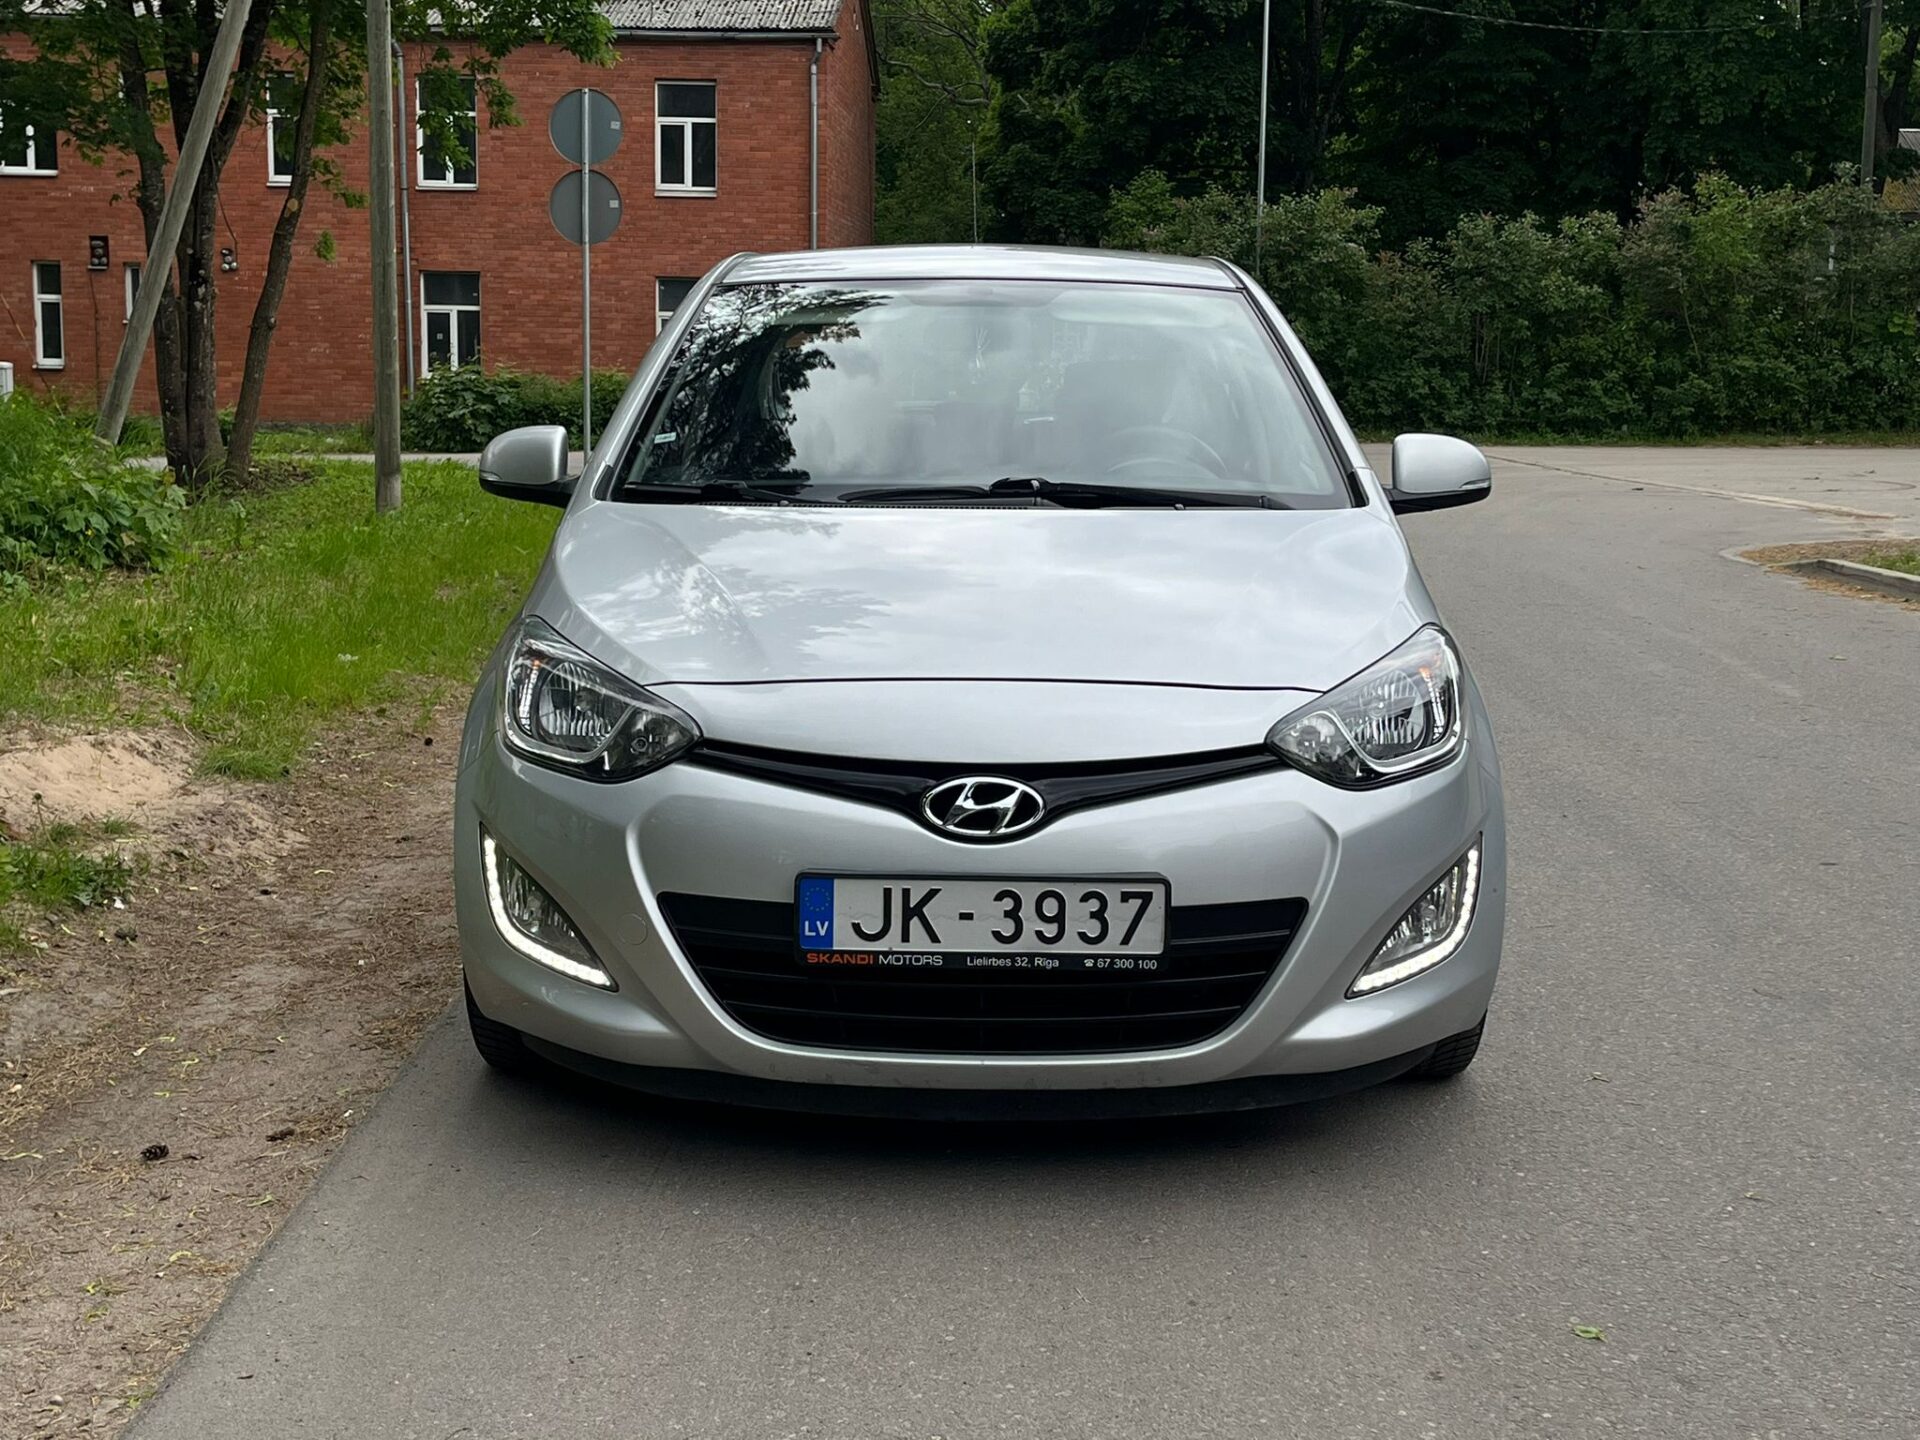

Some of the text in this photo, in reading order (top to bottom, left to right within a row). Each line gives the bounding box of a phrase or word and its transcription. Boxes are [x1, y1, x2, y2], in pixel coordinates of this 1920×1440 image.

[804, 920, 829, 937] LV
[806, 952, 944, 966] SKANDI MOTORS
[966, 956, 1060, 970] Lielirbes 32, Rīga
[1096, 958, 1158, 970] 67 300 100
